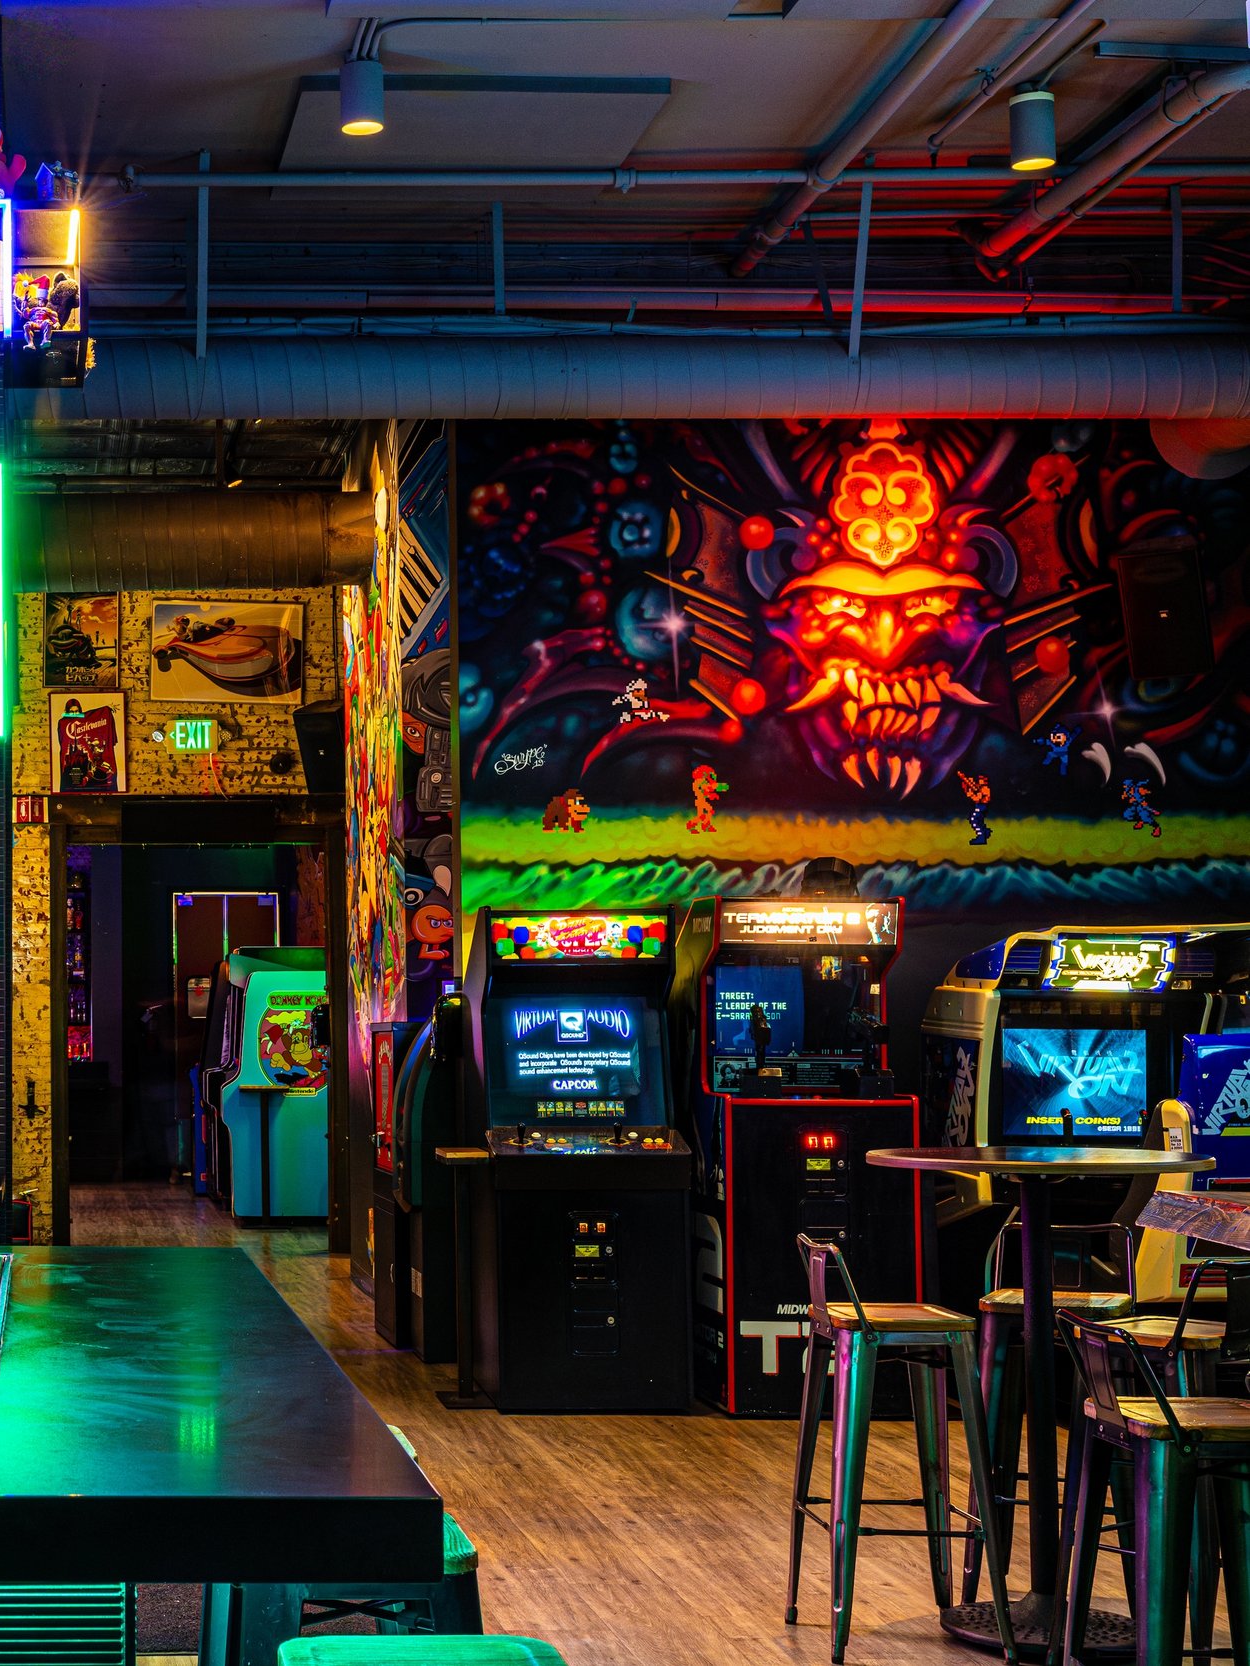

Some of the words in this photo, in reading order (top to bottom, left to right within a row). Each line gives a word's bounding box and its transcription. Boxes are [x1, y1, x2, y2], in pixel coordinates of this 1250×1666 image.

[65, 719, 107, 740] Castlevania
[175, 721, 212, 749] EXIT
[724, 912, 844, 924] TERMINATOR
[846, 912, 861, 925] 2
[739, 925, 815, 934] JUDGMENT
[816, 925, 844, 934] DAY
[270, 995, 302, 1005] DONKEY
[720, 992, 754, 1000] TARGET:
[772, 1002, 787, 1010] THE
[515, 1010, 557, 1038] VIRTUAL
[587, 1009, 630, 1038] AUDIO
[540, 1052, 553, 1060] Chips
[578, 1052, 601, 1060] developed
[602, 1052, 609, 1060] by
[530, 1060, 558, 1068] incorporate
[583, 1059, 609, 1067] proprietary
[1016, 1040, 1143, 1086] VIRTUAL
[536, 1067, 568, 1075] enhancement
[569, 1066, 595, 1075] technology.
[553, 1080, 598, 1090] CAPCOM
[1075, 1116, 1121, 1125] COIN(S)
[776, 1304, 810, 1315] MIDW
